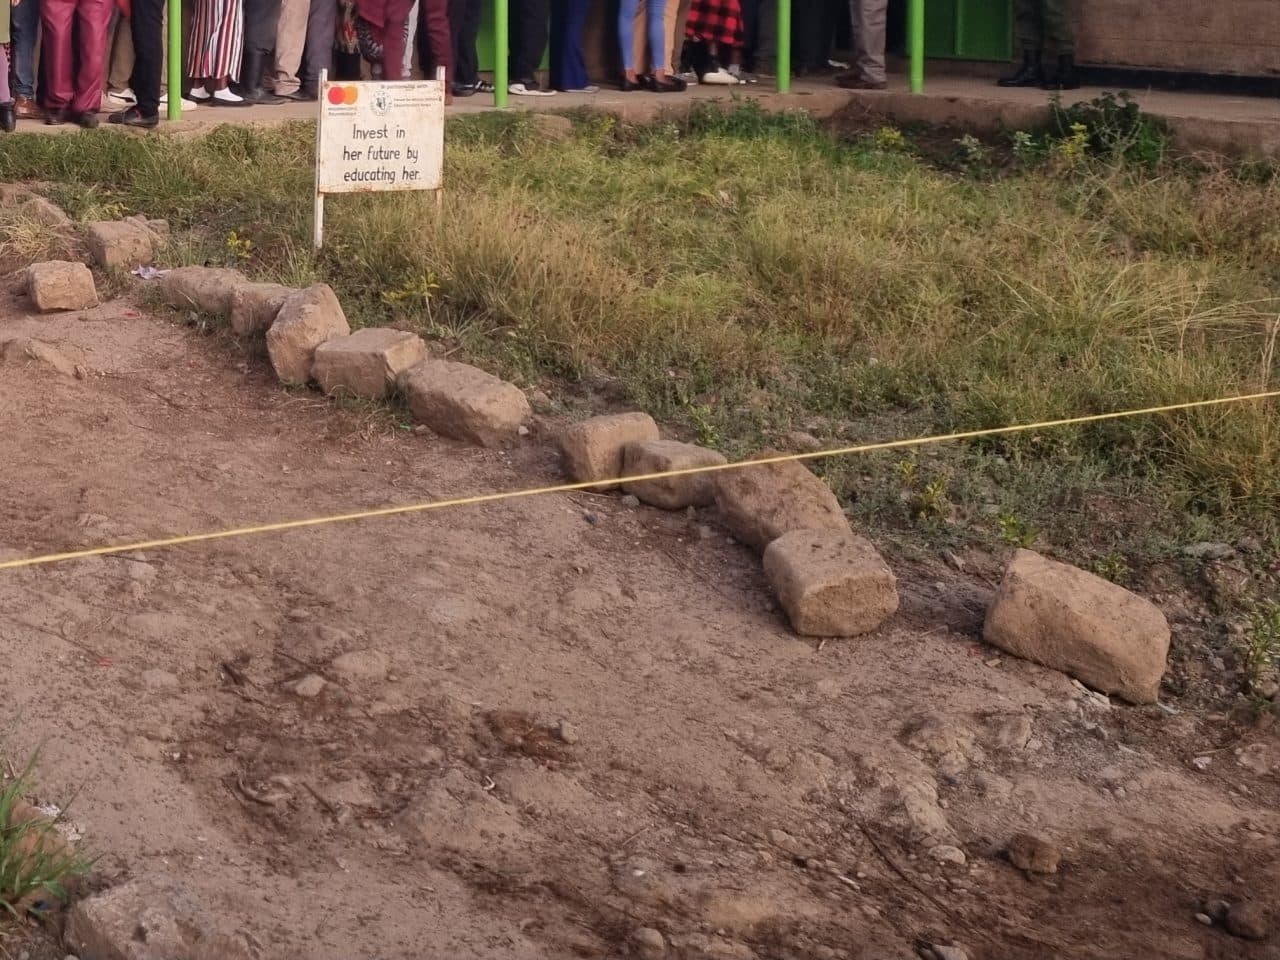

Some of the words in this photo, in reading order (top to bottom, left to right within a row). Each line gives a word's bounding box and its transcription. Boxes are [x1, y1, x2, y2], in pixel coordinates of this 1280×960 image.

[353, 124, 388, 139] Invest
[396, 125, 406, 139] in
[343, 146, 362, 160] her
[367, 145, 400, 160] future
[407, 146, 419, 163] by
[344, 166, 396, 184] educating
